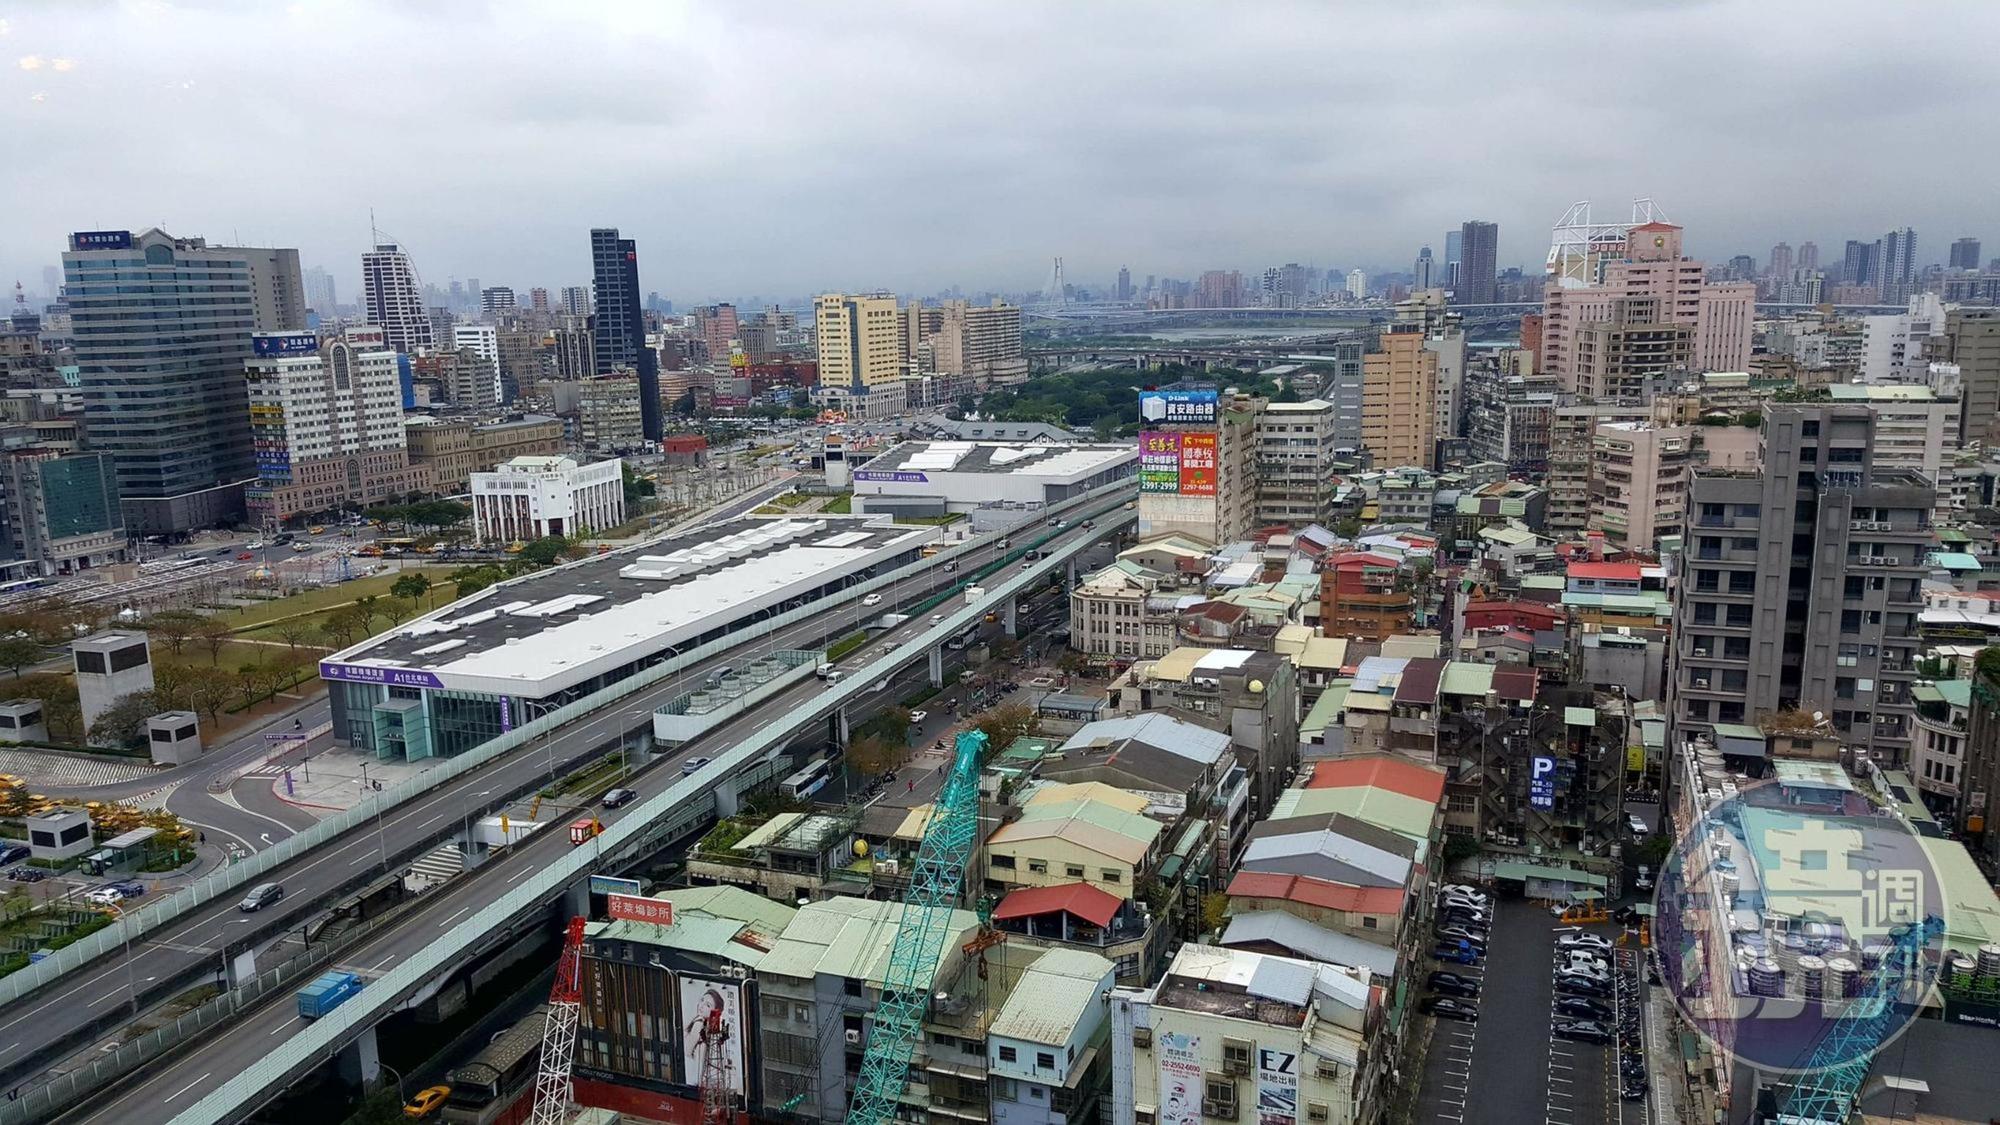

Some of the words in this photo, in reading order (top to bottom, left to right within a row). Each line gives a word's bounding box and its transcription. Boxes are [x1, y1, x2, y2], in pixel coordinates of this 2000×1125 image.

[1533, 757, 1553, 779] P
[1531, 796, 1552, 807] 停車場
[1260, 1049, 1295, 1075] EZ
[1260, 1072, 1296, 1087] 場地出租
